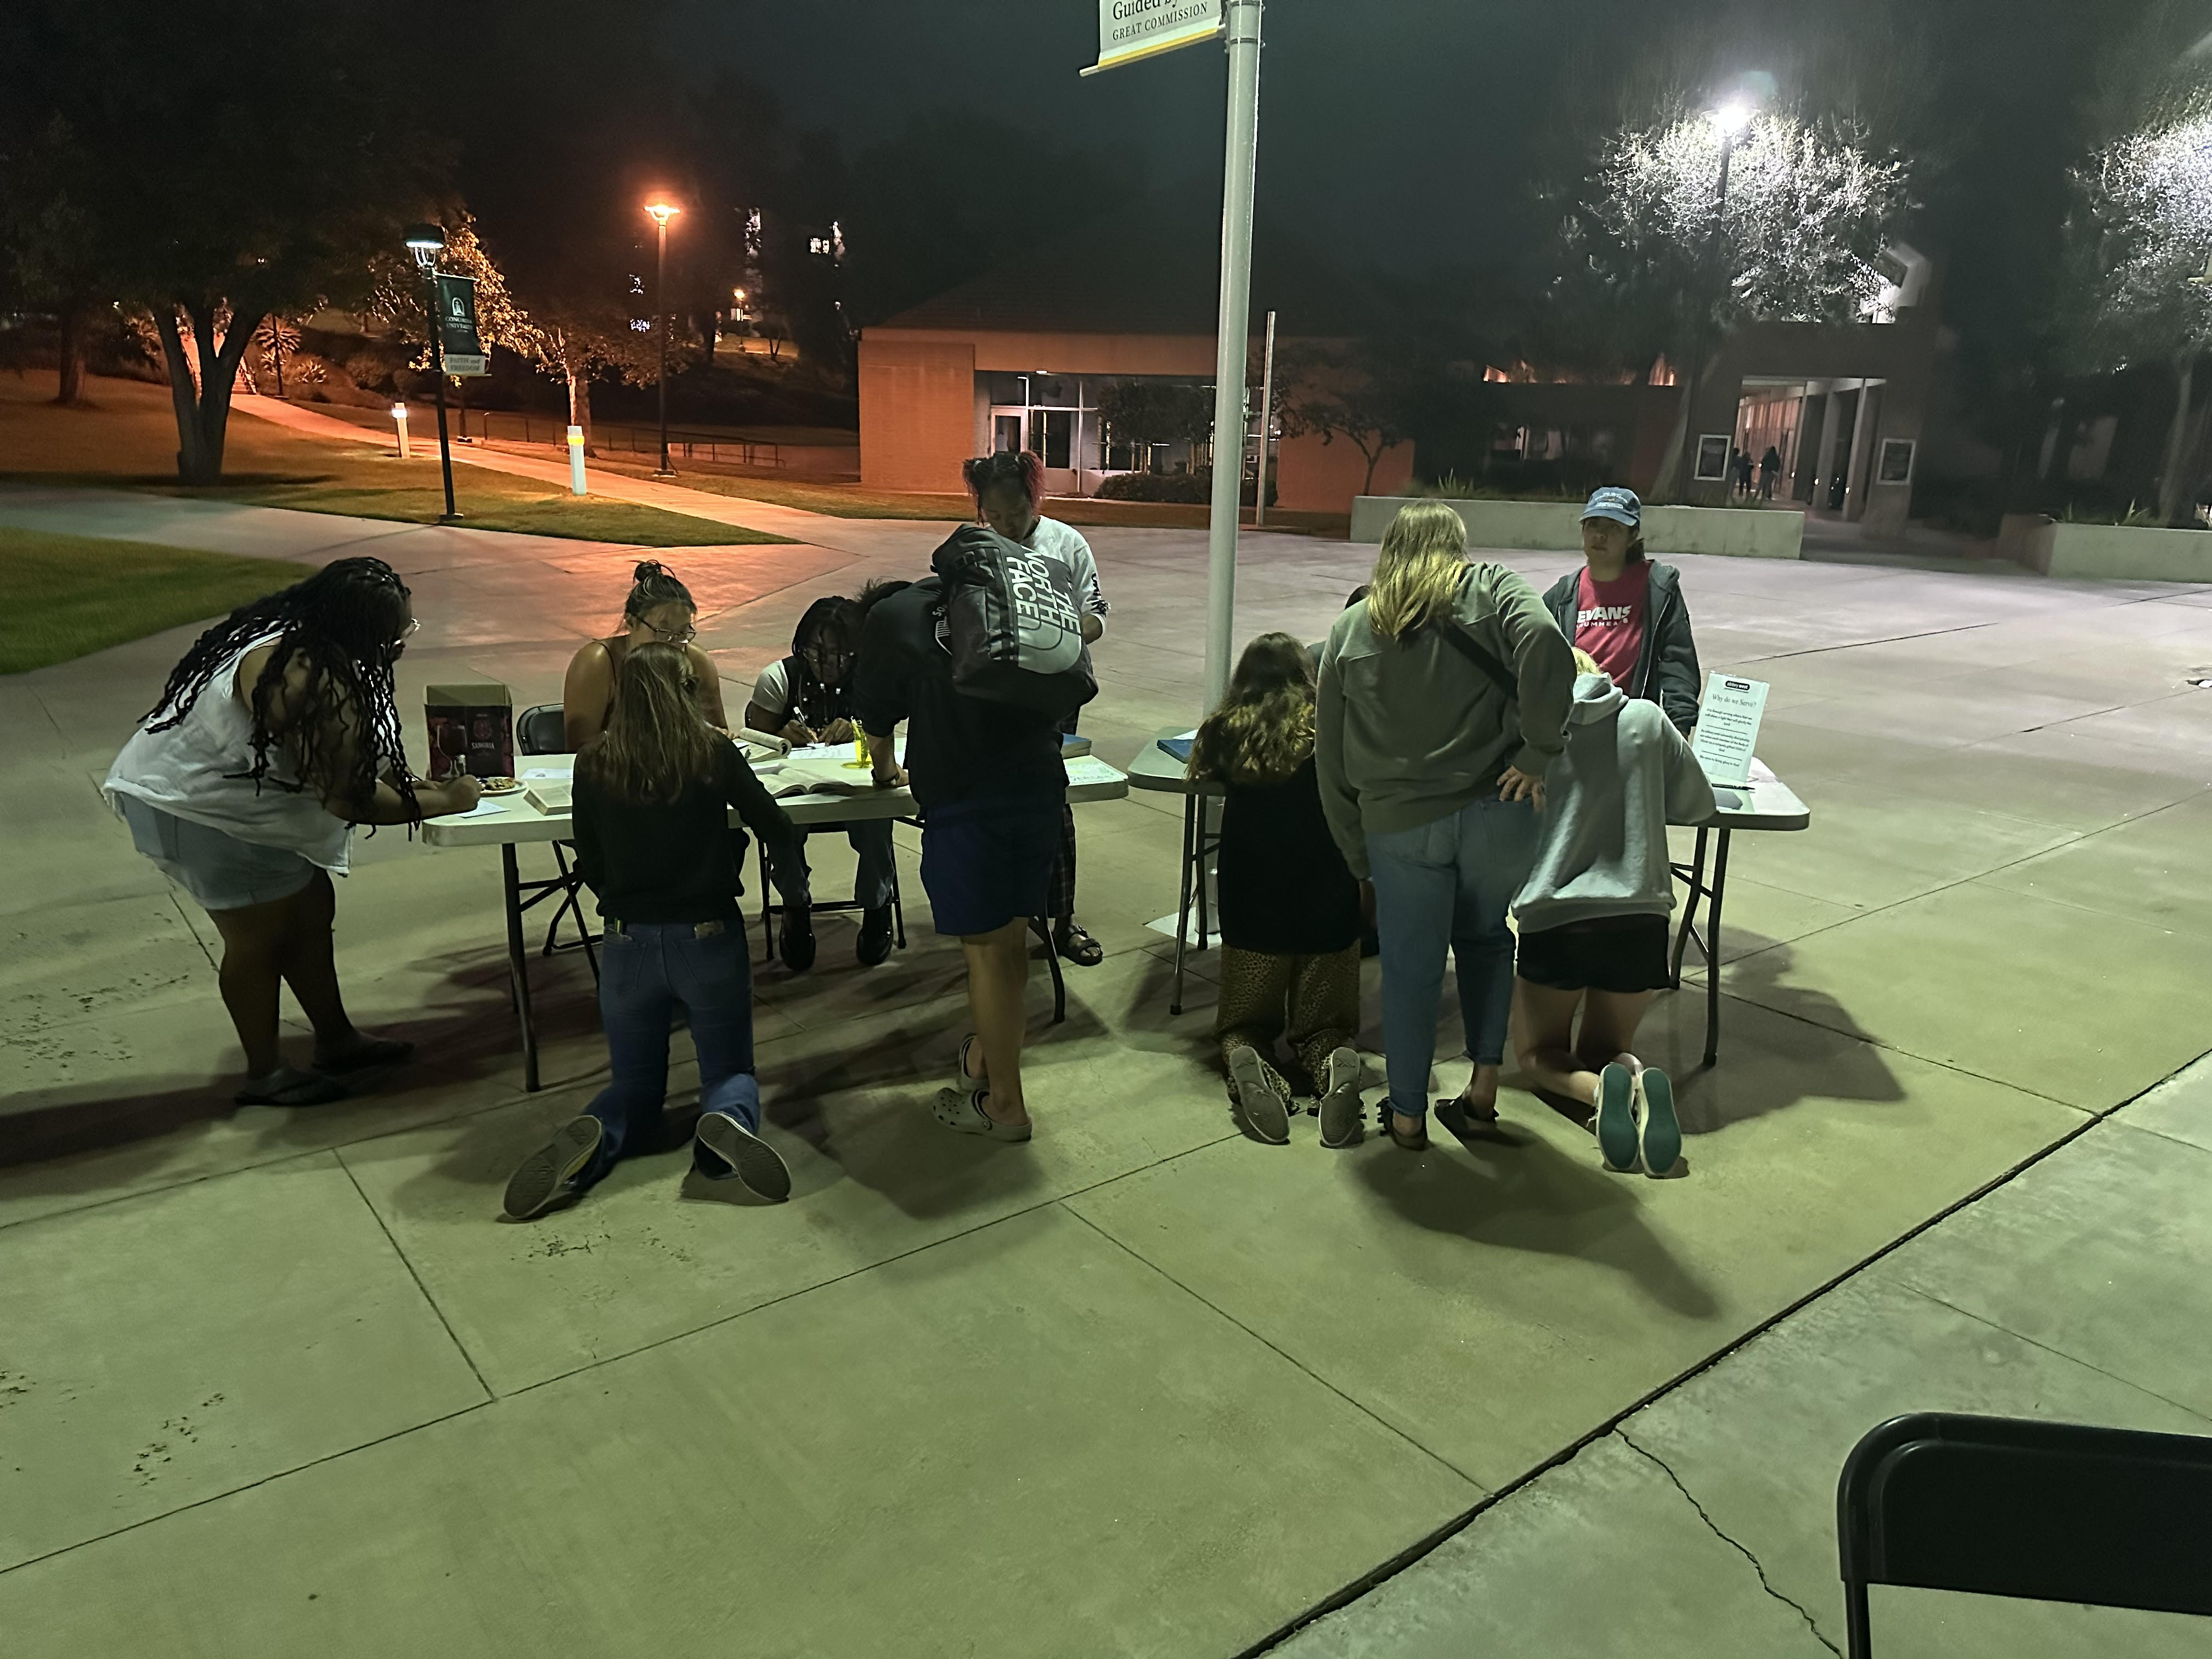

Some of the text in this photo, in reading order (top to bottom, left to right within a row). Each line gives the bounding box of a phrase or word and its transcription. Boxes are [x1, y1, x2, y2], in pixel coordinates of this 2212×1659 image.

[1113, 2, 1207, 41] GREAT COMMISSION
[1006, 557, 1039, 620] FACE
[1020, 545, 1063, 628] NORTH
[1053, 589, 1081, 635] THE
[1577, 605, 1633, 623] EVANS
[1713, 694, 1723, 702] Why
